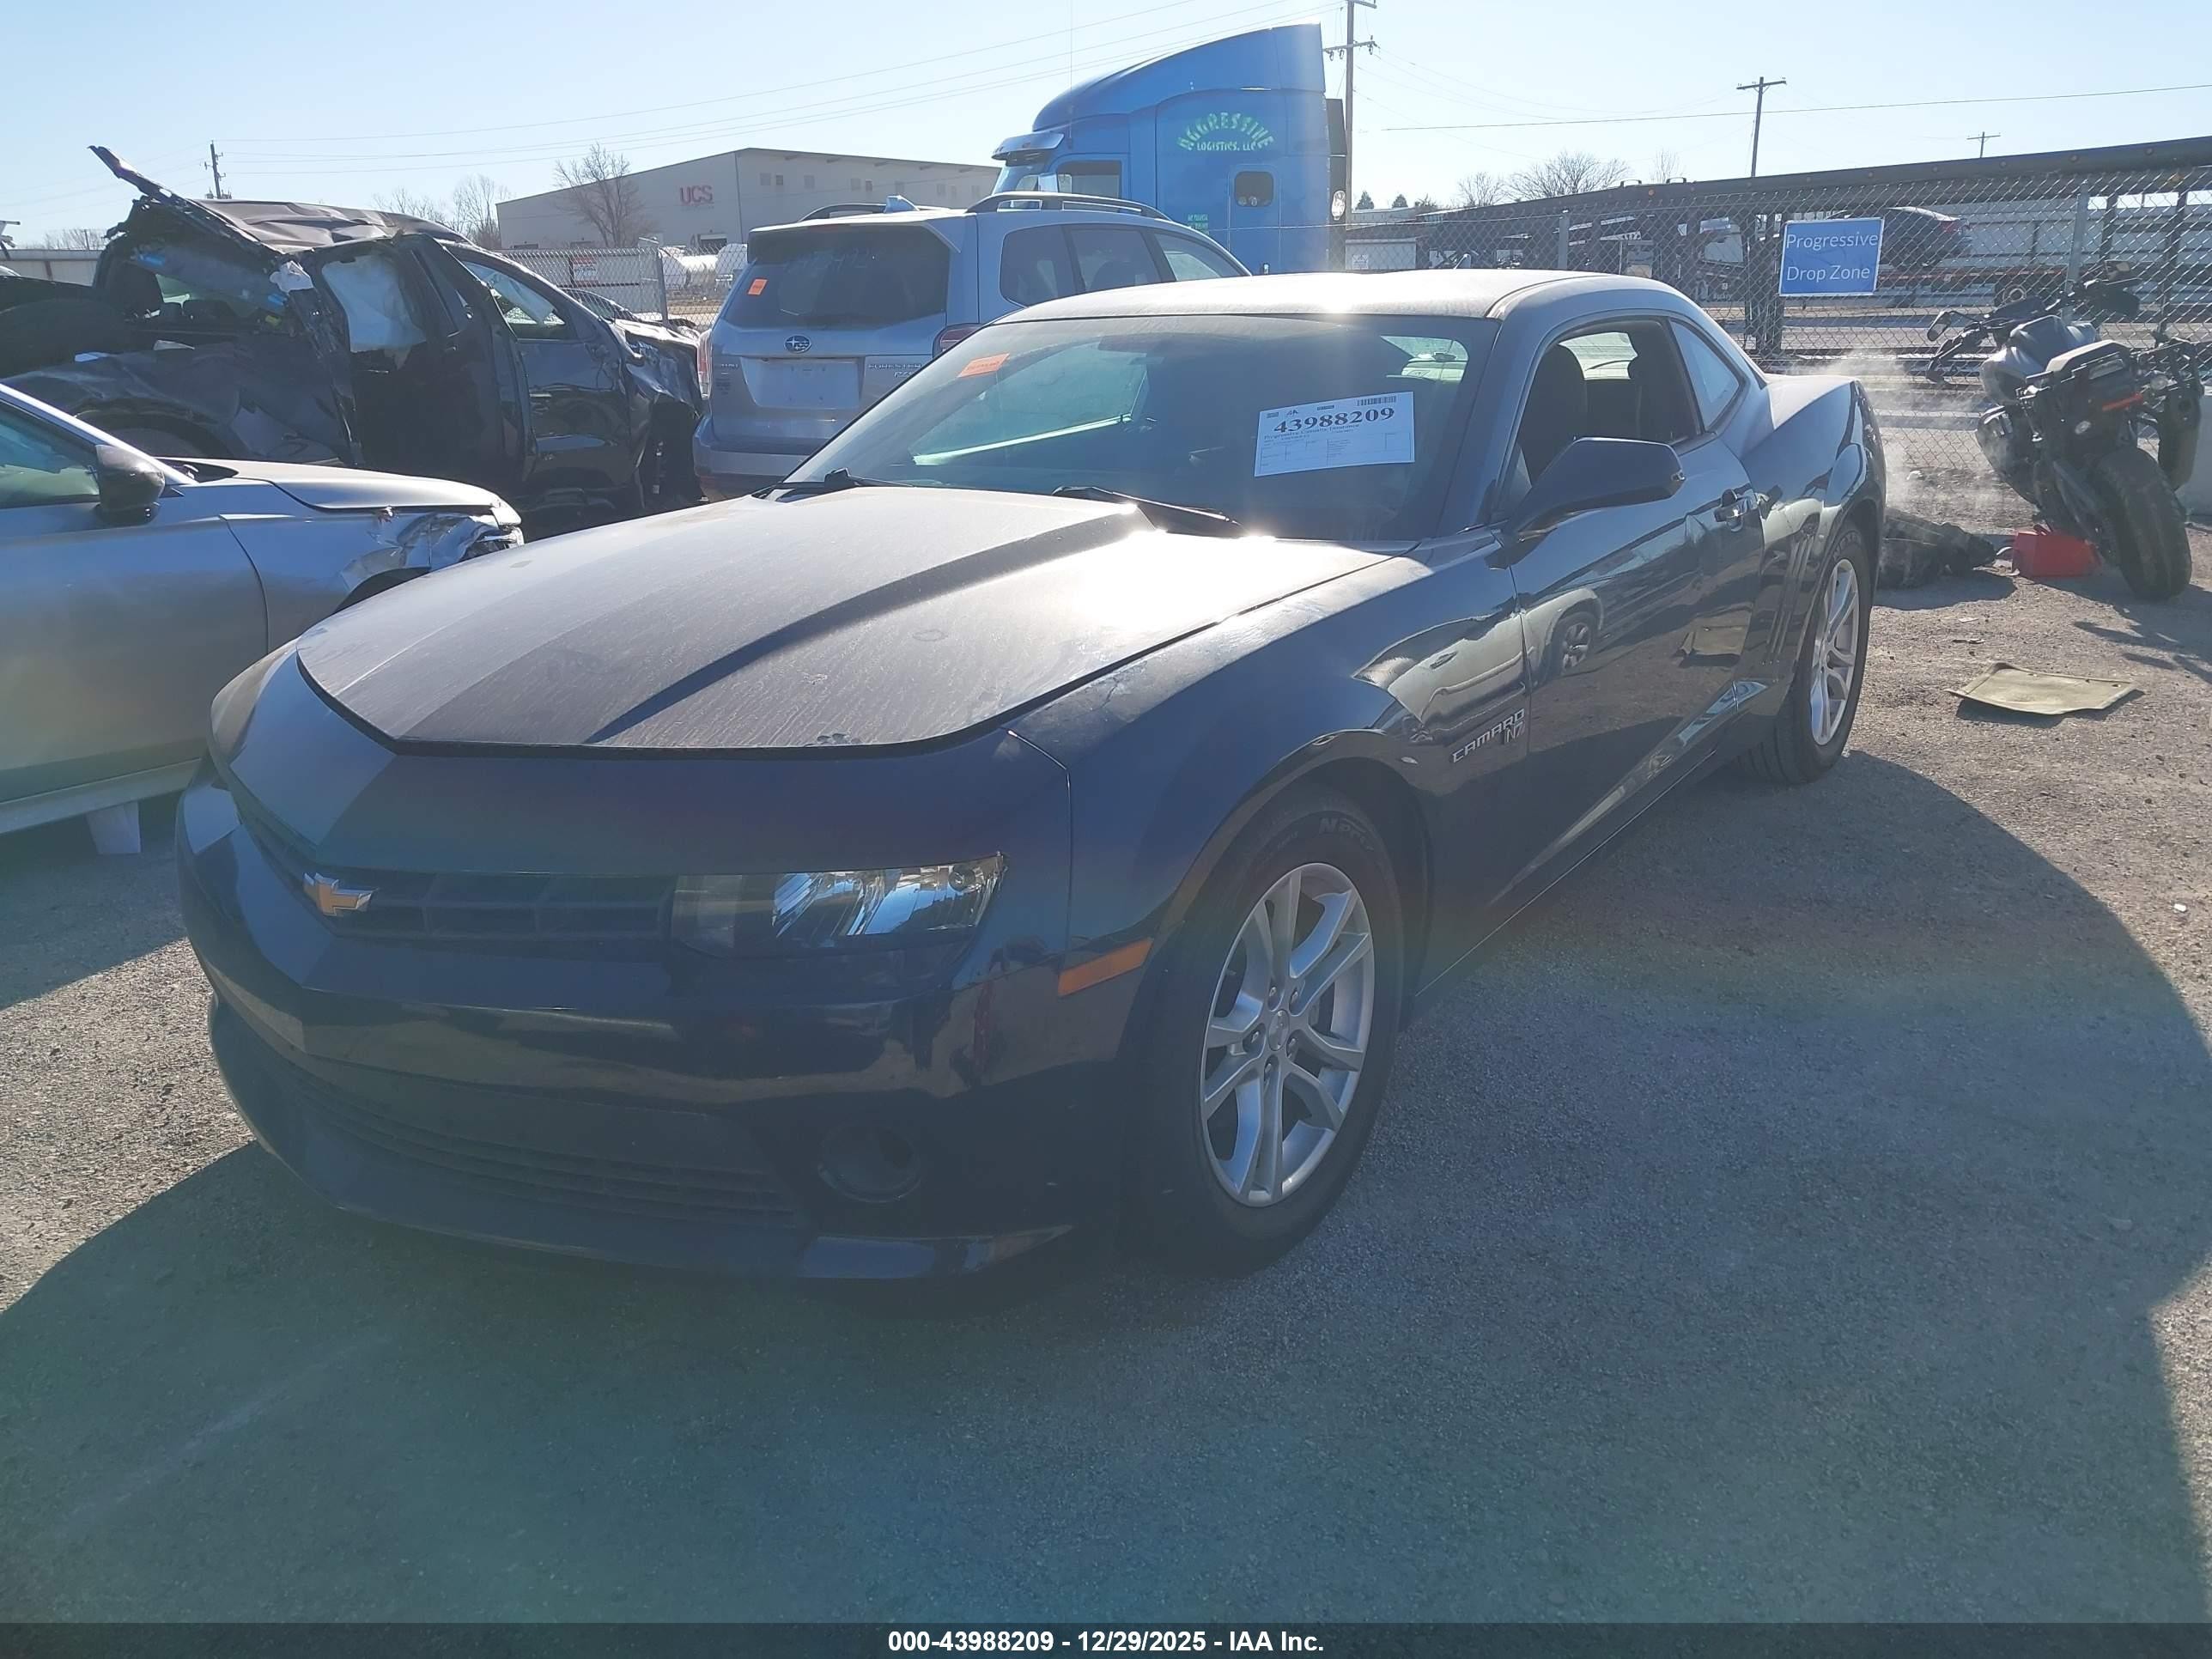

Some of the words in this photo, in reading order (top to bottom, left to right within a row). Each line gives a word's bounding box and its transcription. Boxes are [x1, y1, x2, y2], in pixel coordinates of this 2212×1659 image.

[1243, 141, 1257, 151] LLC
[679, 185, 714, 205] UCS
[1786, 232, 1879, 252] Progressive
[1786, 265, 1826, 283] Drop
[1829, 264, 1870, 281] Zone
[1273, 407, 1395, 434] 43988209
[1452, 708, 1525, 763] CAMARO
